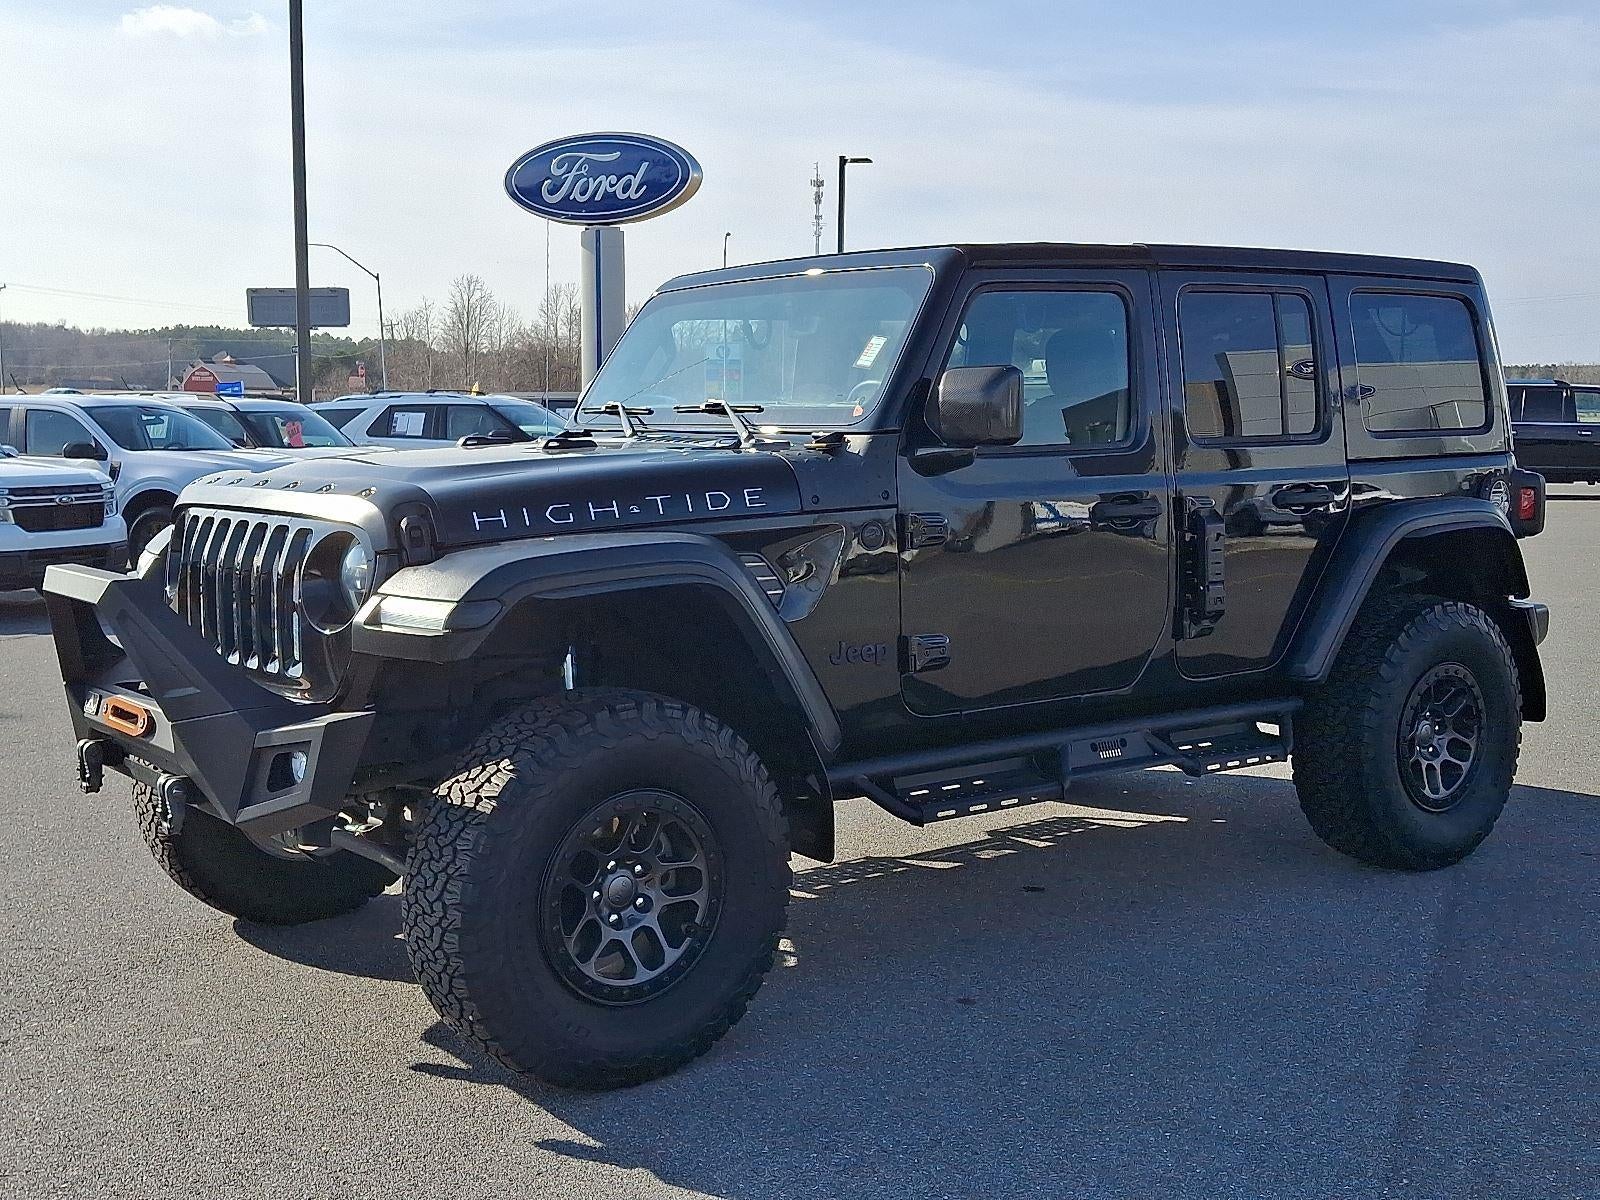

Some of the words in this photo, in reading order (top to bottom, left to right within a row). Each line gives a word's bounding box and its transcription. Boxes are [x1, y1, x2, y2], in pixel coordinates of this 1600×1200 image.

[542, 151, 649, 204] Ford
[472, 500, 620, 531] HIGH
[644, 488, 767, 515] TIDE
[829, 641, 888, 666] Jeep
